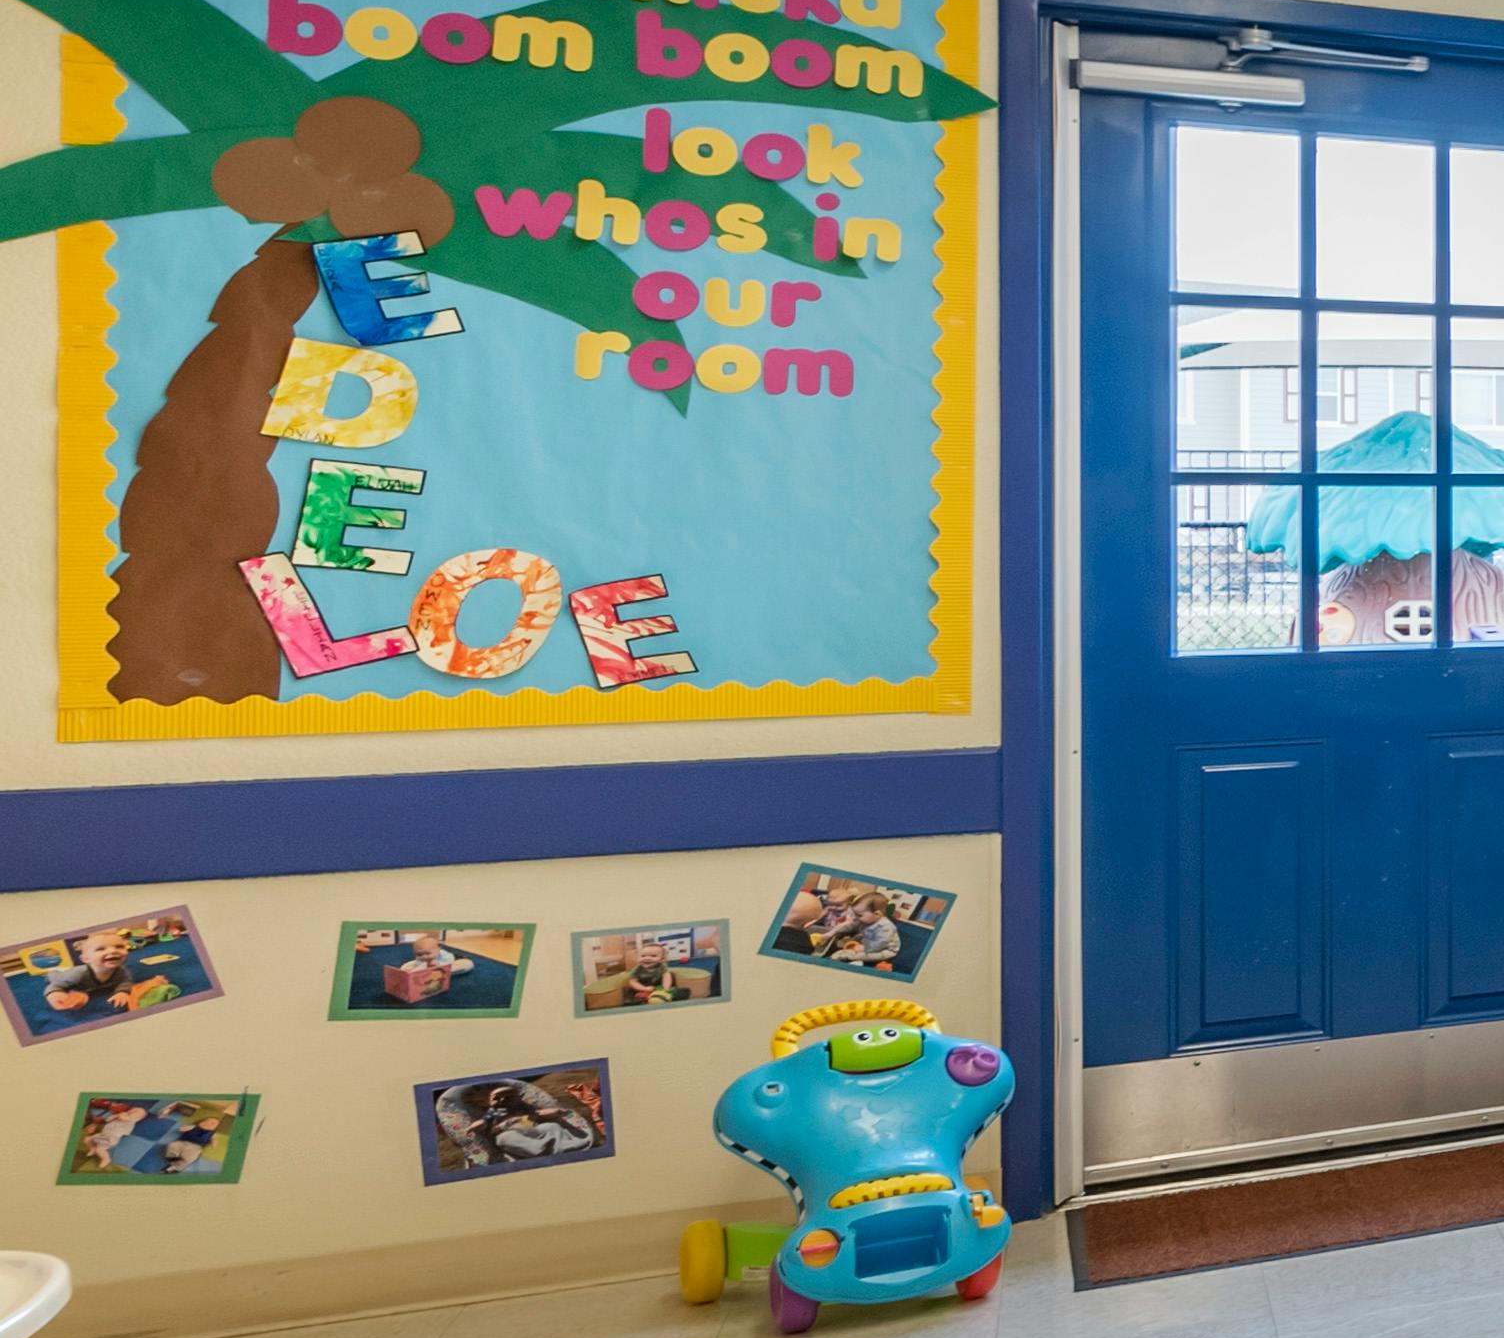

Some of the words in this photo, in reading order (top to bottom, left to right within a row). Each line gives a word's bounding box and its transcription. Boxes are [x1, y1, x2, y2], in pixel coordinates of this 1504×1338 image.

[636, 8, 924, 98] boom
[645, 107, 863, 188] look
[474, 179, 768, 253] whos
[814, 193, 901, 263] in
[633, 271, 822, 327] our
[574, 330, 855, 396] room
